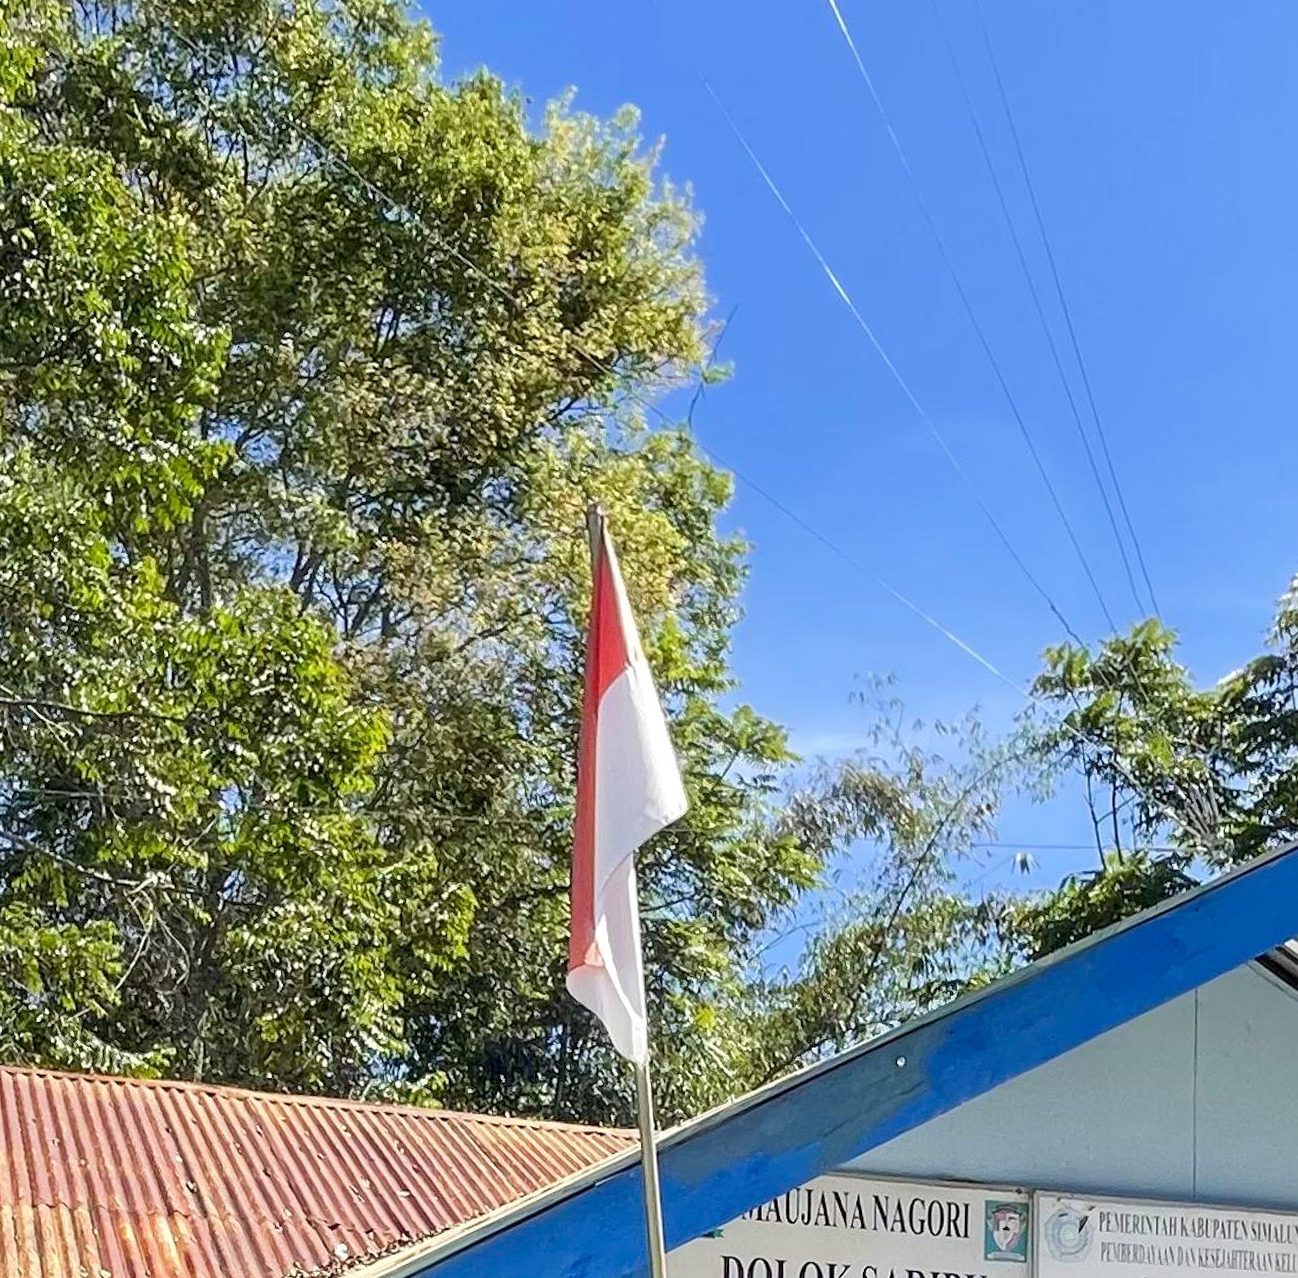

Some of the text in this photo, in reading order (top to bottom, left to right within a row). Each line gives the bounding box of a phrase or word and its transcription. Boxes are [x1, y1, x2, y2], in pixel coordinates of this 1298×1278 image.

[873, 1193, 970, 1238] NAGORI
[1099, 1211, 1178, 1236] PEMERINTAH
[1181, 1216, 1248, 1241] KABUPATEN
